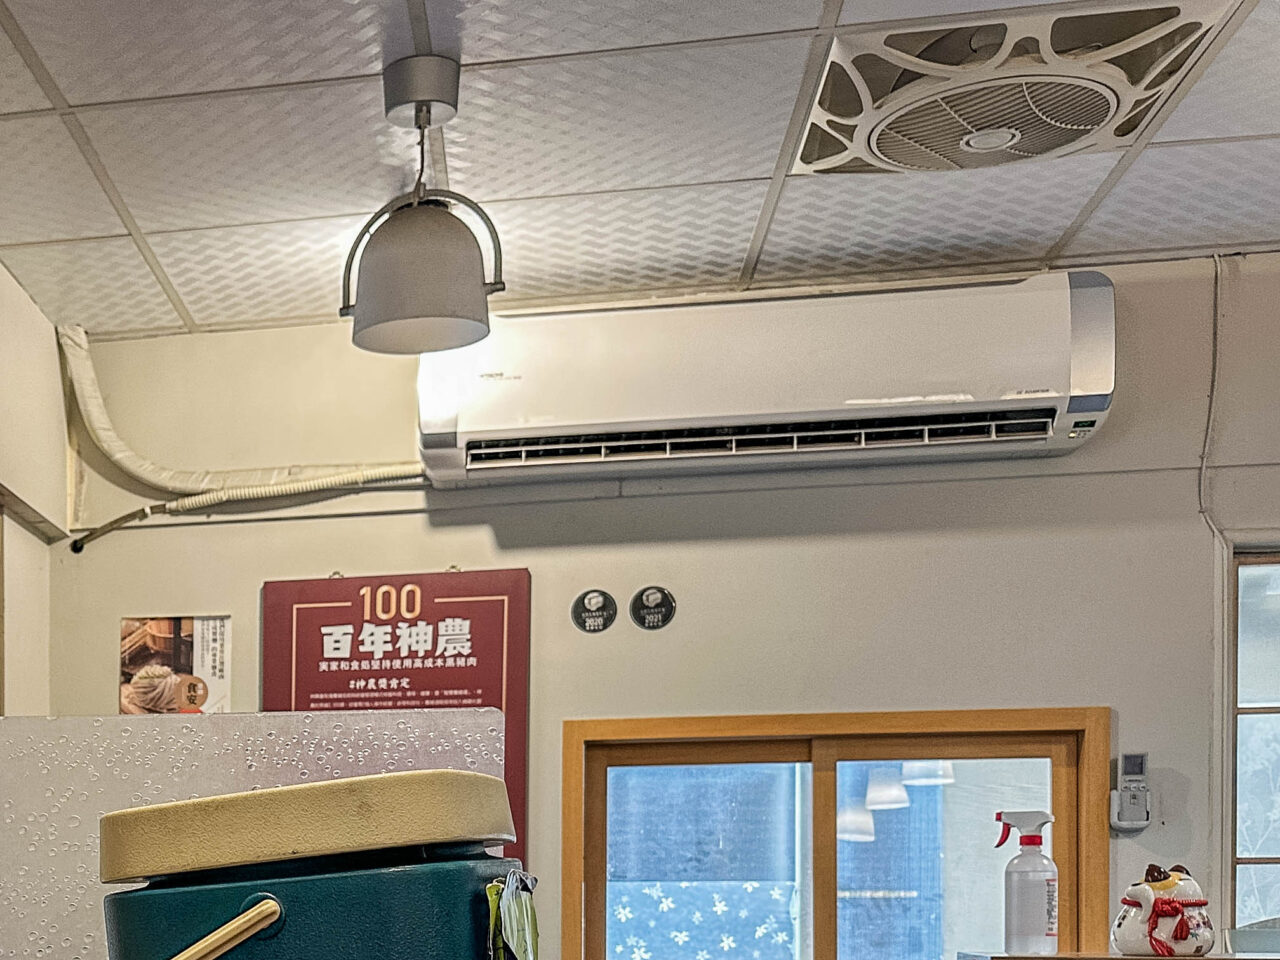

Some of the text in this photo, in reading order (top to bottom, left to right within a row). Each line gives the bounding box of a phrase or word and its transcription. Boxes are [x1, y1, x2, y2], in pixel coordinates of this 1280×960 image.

[359, 583, 422, 621] 100
[320, 617, 473, 660] 百年神農
